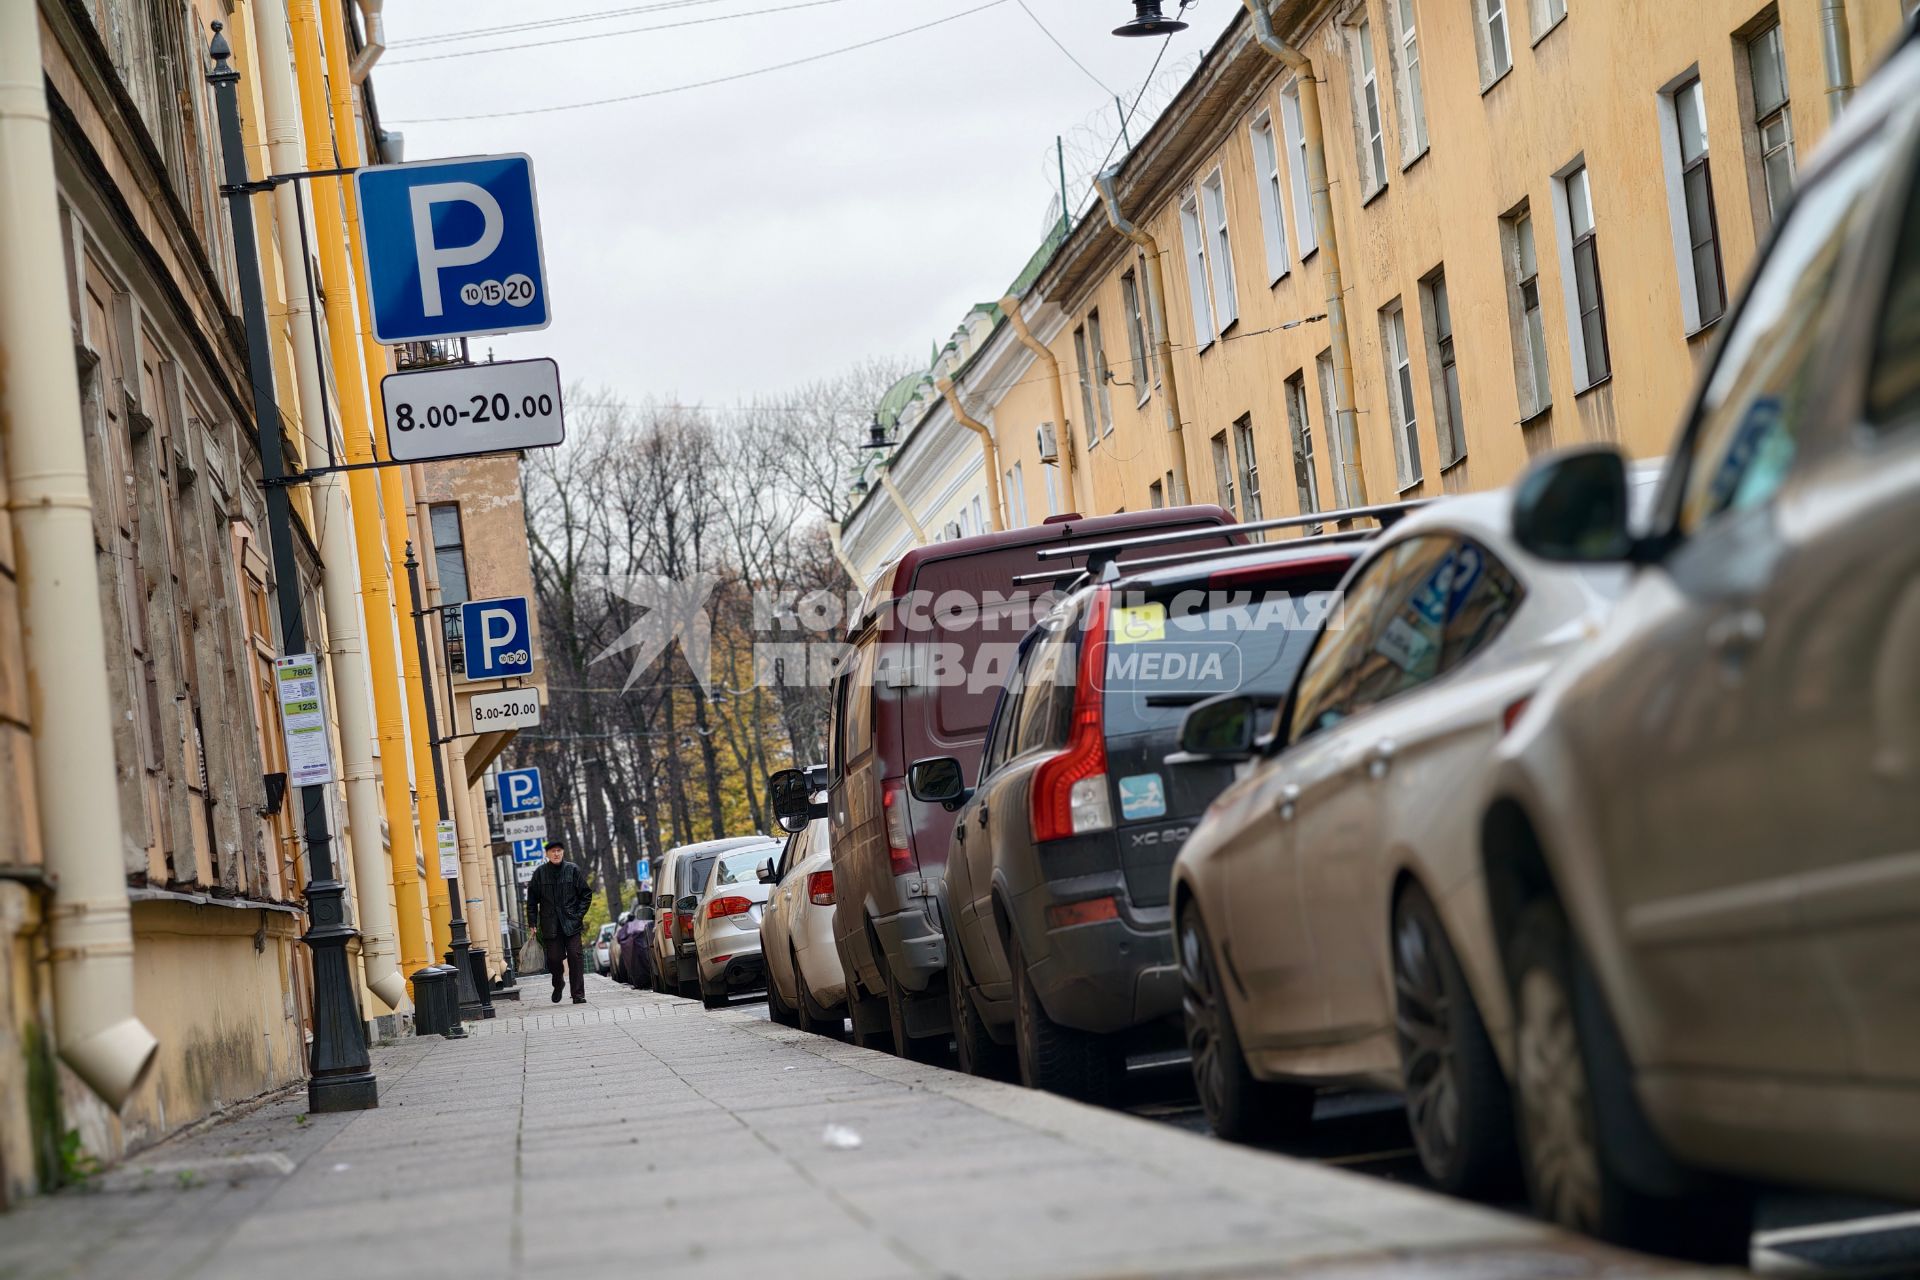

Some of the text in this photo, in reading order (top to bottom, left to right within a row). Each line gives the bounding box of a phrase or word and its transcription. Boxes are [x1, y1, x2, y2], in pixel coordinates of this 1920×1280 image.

[408, 181, 504, 317] P
[465, 280, 533, 301] 10 15 20
[395, 392, 553, 432] 8.00-20.00
[480, 608, 517, 670] P
[507, 654, 515, 662] 15
[516, 652, 527, 662] 20
[292, 667, 313, 677] 7802
[298, 702, 318, 712] 1233
[475, 703, 536, 720] 8.00-20.00
[508, 774, 533, 808] P
[520, 839, 537, 860] P
[1131, 831, 1159, 847] XC
